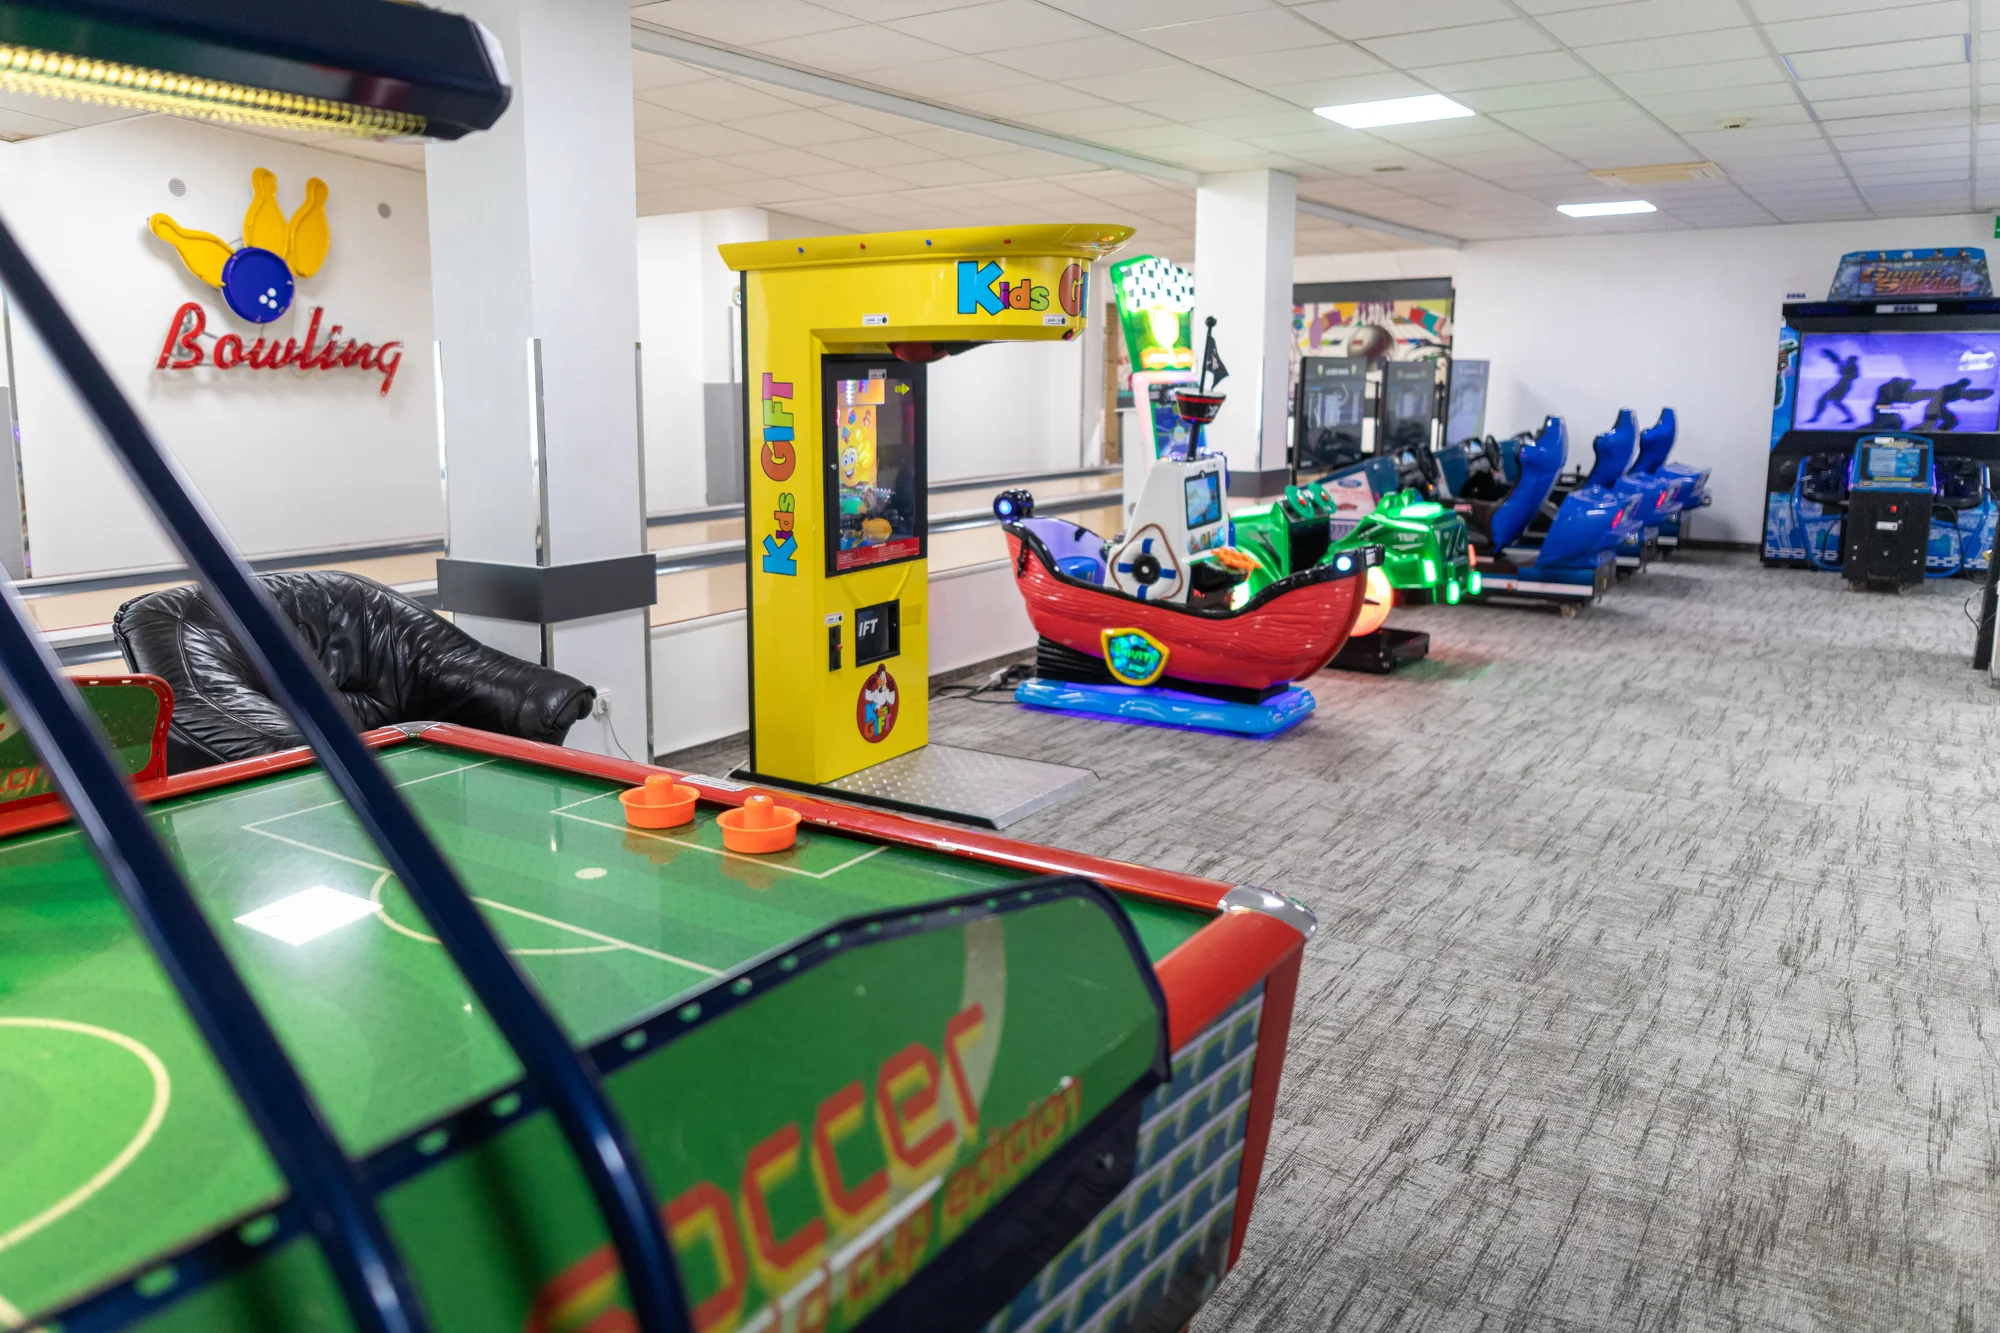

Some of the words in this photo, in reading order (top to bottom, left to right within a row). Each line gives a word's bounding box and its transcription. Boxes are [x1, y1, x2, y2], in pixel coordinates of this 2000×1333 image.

[957, 260, 1050, 316] Kids
[1058, 263, 1089, 318] GI
[1893, 304, 1920, 313] SEGA
[156, 302, 403, 396] Bowling
[761, 372, 797, 482] GIFT
[762, 492, 798, 576] Kids
[858, 618, 879, 637] IFT
[864, 713, 892, 738] GIFT
